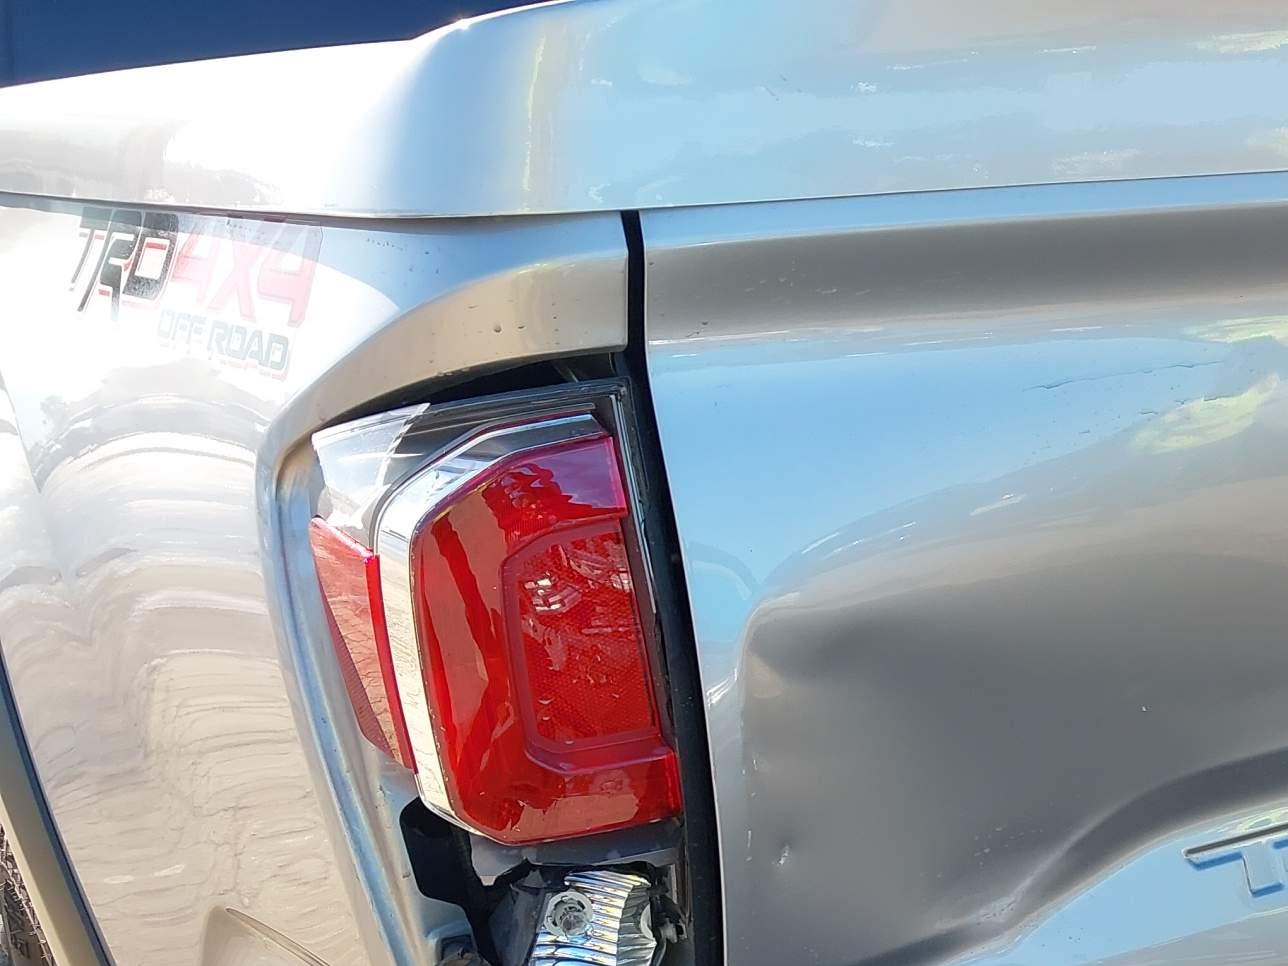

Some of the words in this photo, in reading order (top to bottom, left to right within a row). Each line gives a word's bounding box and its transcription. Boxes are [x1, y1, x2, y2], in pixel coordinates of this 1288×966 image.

[68, 207, 179, 319] TRD
[157, 308, 206, 352] OFF
[206, 324, 290, 374] ROAD
